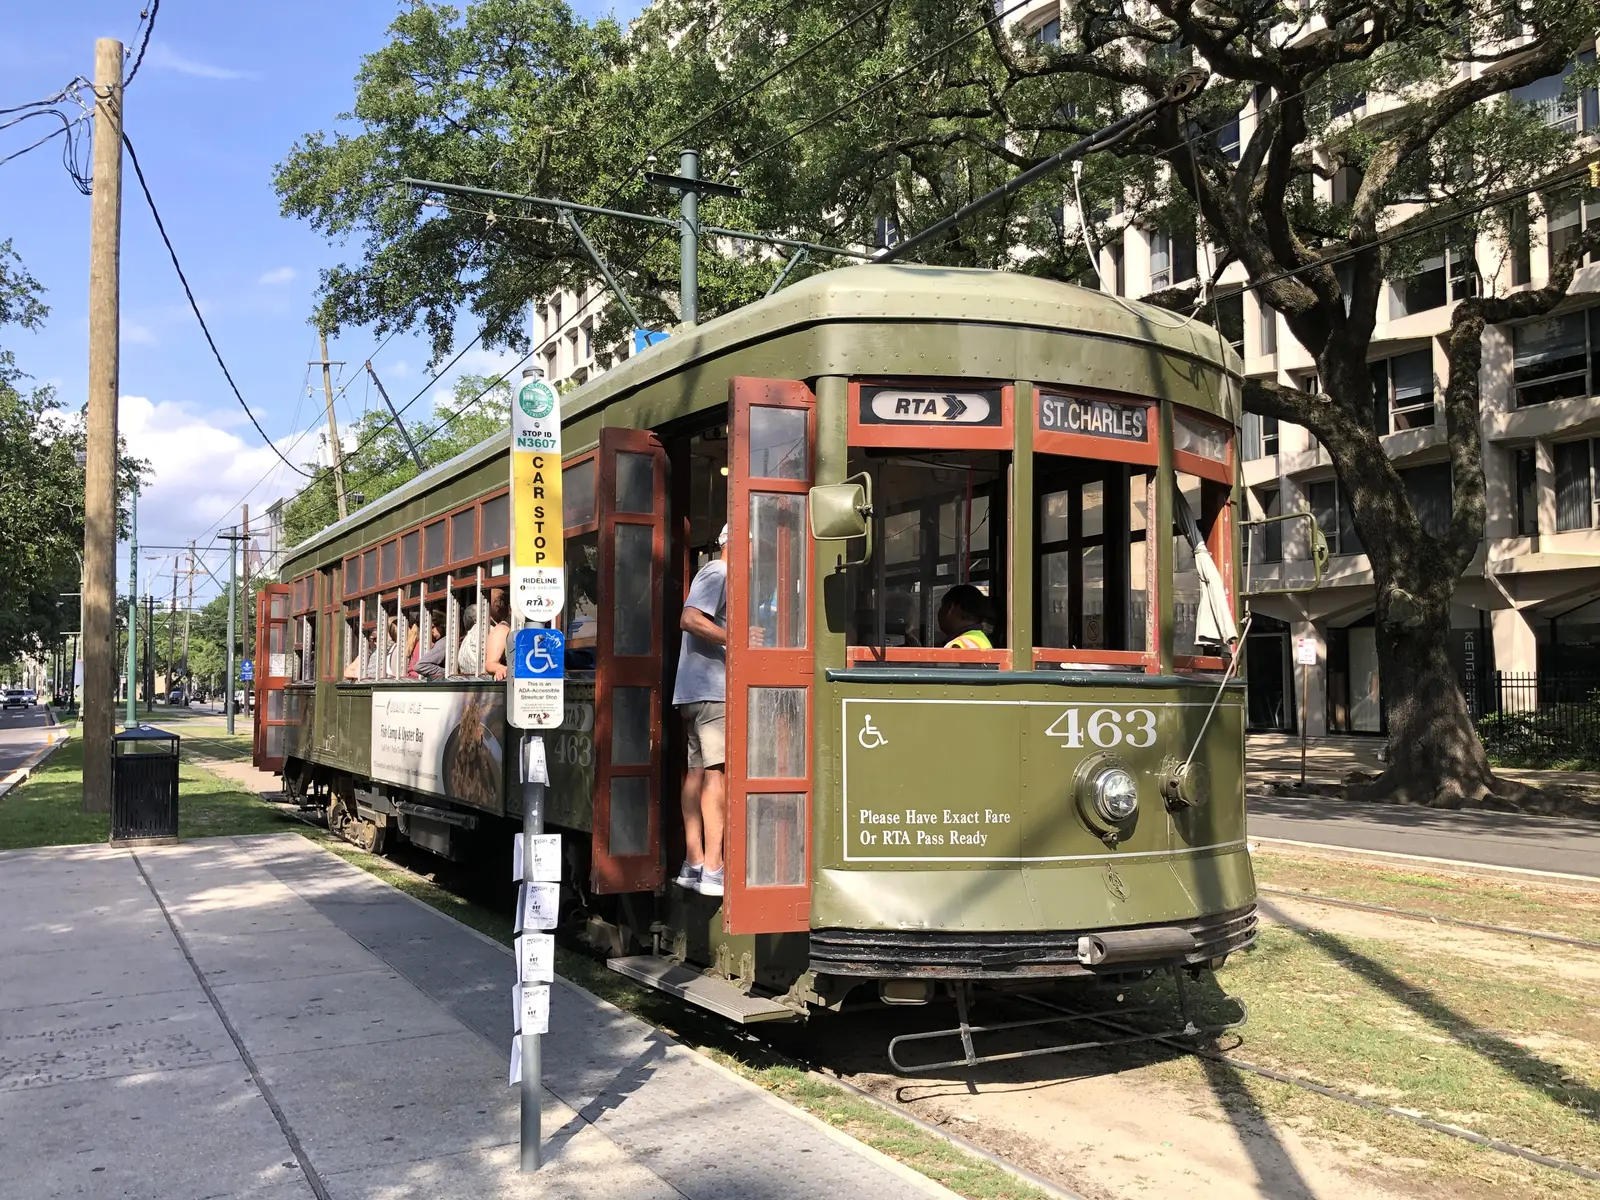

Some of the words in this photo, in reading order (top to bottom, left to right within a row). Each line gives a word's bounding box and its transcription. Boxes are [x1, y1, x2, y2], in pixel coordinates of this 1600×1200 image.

[895, 398, 938, 415] RTA
[1042, 399, 1143, 437] ST.CHARLES
[517, 437, 556, 448] N3607
[532, 456, 544, 499] CAR
[534, 506, 546, 564] STOP
[387, 725, 397, 742] Camp
[402, 727, 415, 743] Oyster
[415, 728, 424, 742] Bar
[1044, 708, 1157, 748] 463
[554, 734, 591, 767] 463
[859, 809, 900, 824] Please
[905, 809, 938, 824] Have
[943, 809, 979, 824] Exact
[985, 809, 1010, 824] Fare
[860, 830, 877, 845] Or
[883, 830, 911, 845] RTA
[917, 830, 944, 845] Pass
[950, 830, 988, 847] Ready
